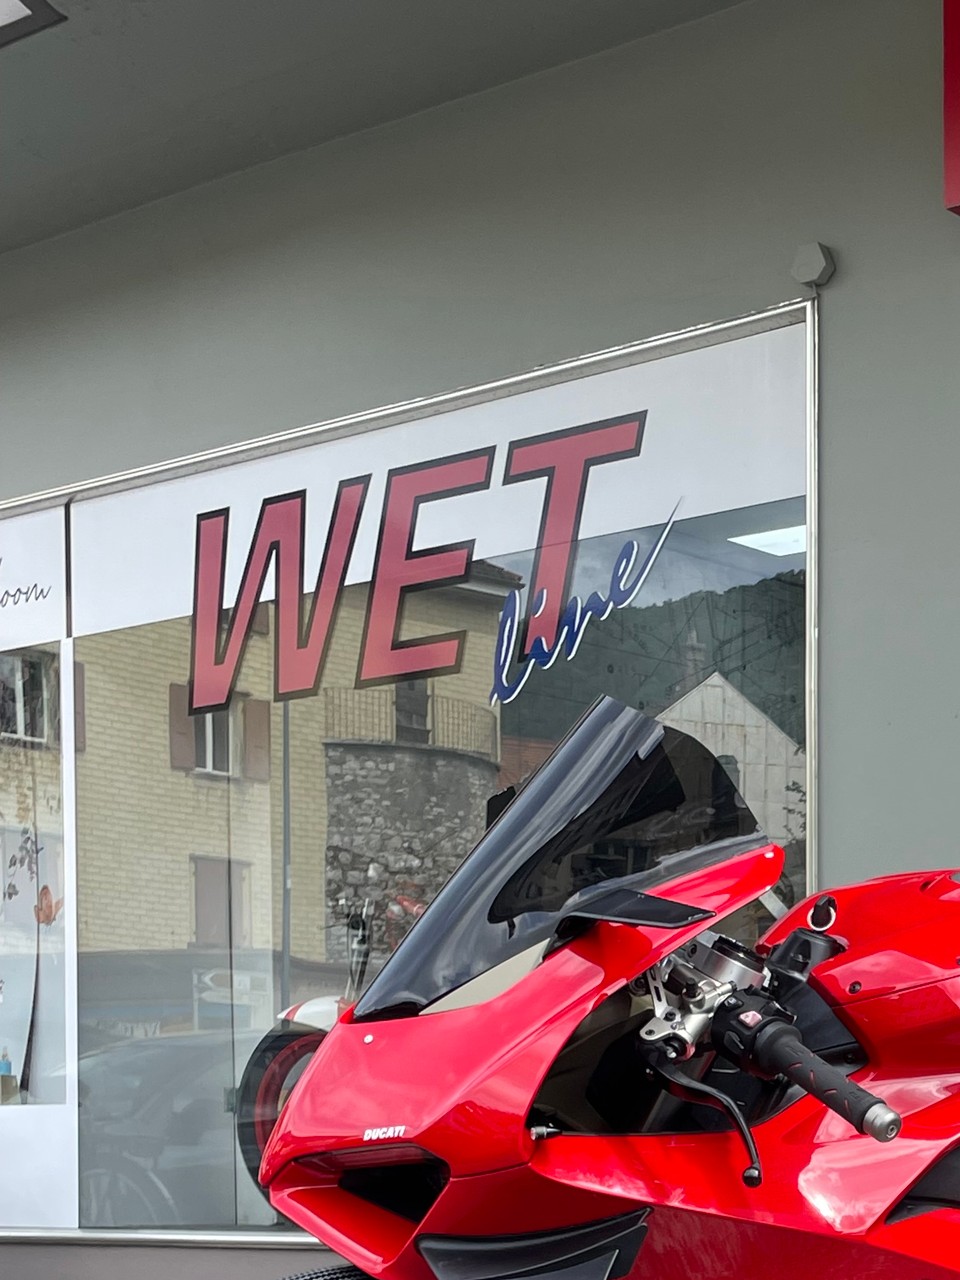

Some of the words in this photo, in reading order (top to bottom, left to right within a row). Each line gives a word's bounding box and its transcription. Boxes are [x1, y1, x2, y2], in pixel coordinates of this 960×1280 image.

[0, 582, 52, 608] oom
[188, 409, 648, 716] WET
[490, 496, 685, 706] line
[362, 1125, 406, 1141] DUCATI
